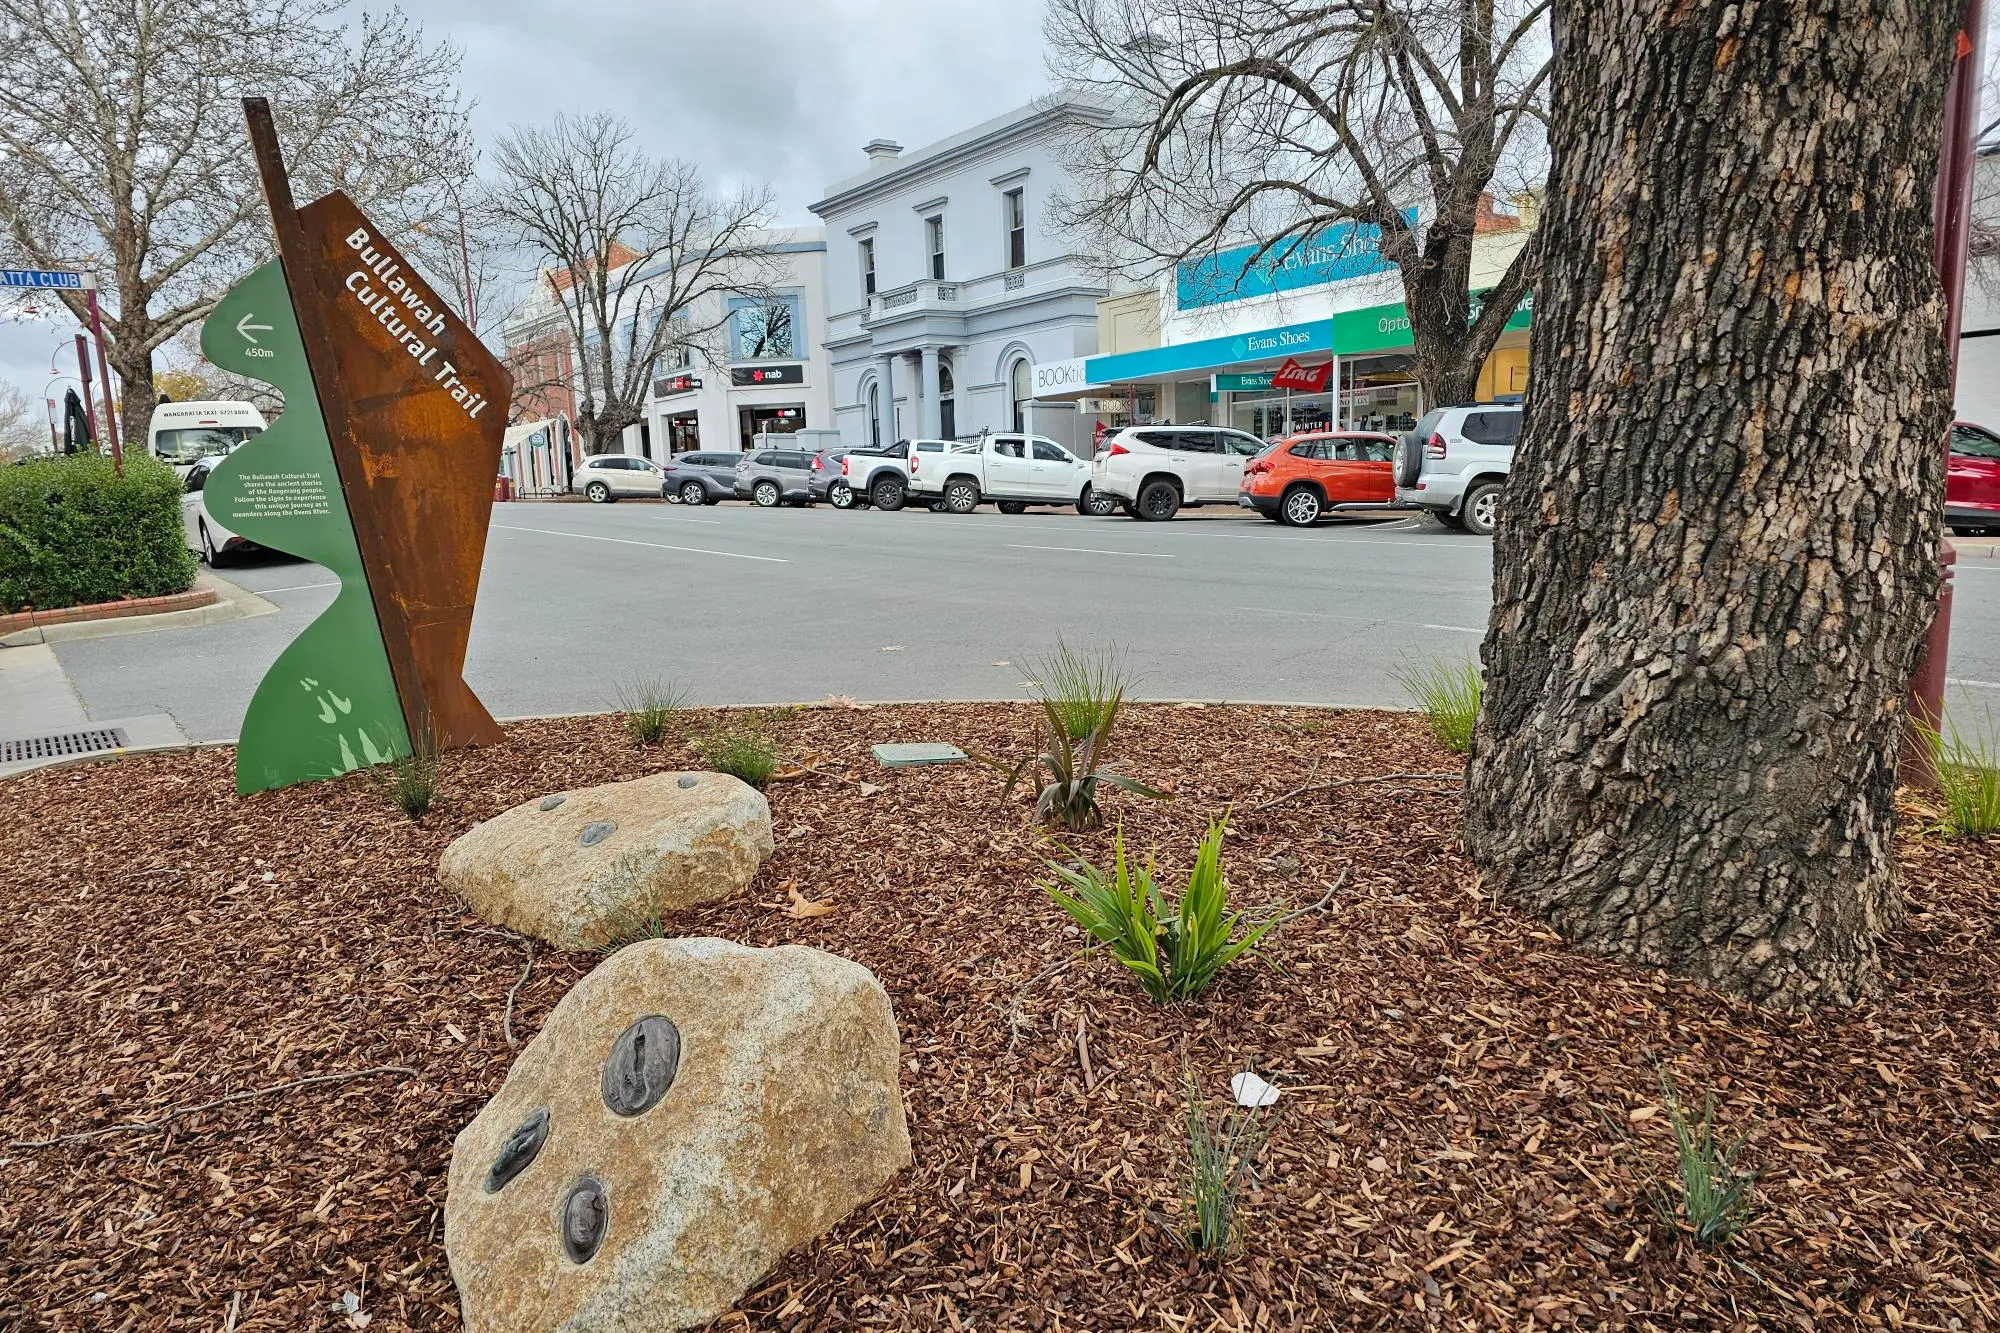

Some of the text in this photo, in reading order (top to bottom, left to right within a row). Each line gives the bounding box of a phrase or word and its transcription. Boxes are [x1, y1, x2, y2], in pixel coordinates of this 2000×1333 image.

[1283, 233, 1382, 270] Evans Shoe
[0, 272, 78, 287] ATTA CLUB
[345, 227, 447, 337] Bullawah
[1378, 317, 1410, 335] Opto
[345, 271, 487, 419] Cultural Trail
[1248, 337, 1277, 351] Evans
[1280, 331, 1309, 346] Shoes
[245, 348, 273, 358] 450m
[765, 370, 782, 378] nab
[1241, 377, 1257, 385] Evans
[1296, 421, 1322, 430] WINTER
